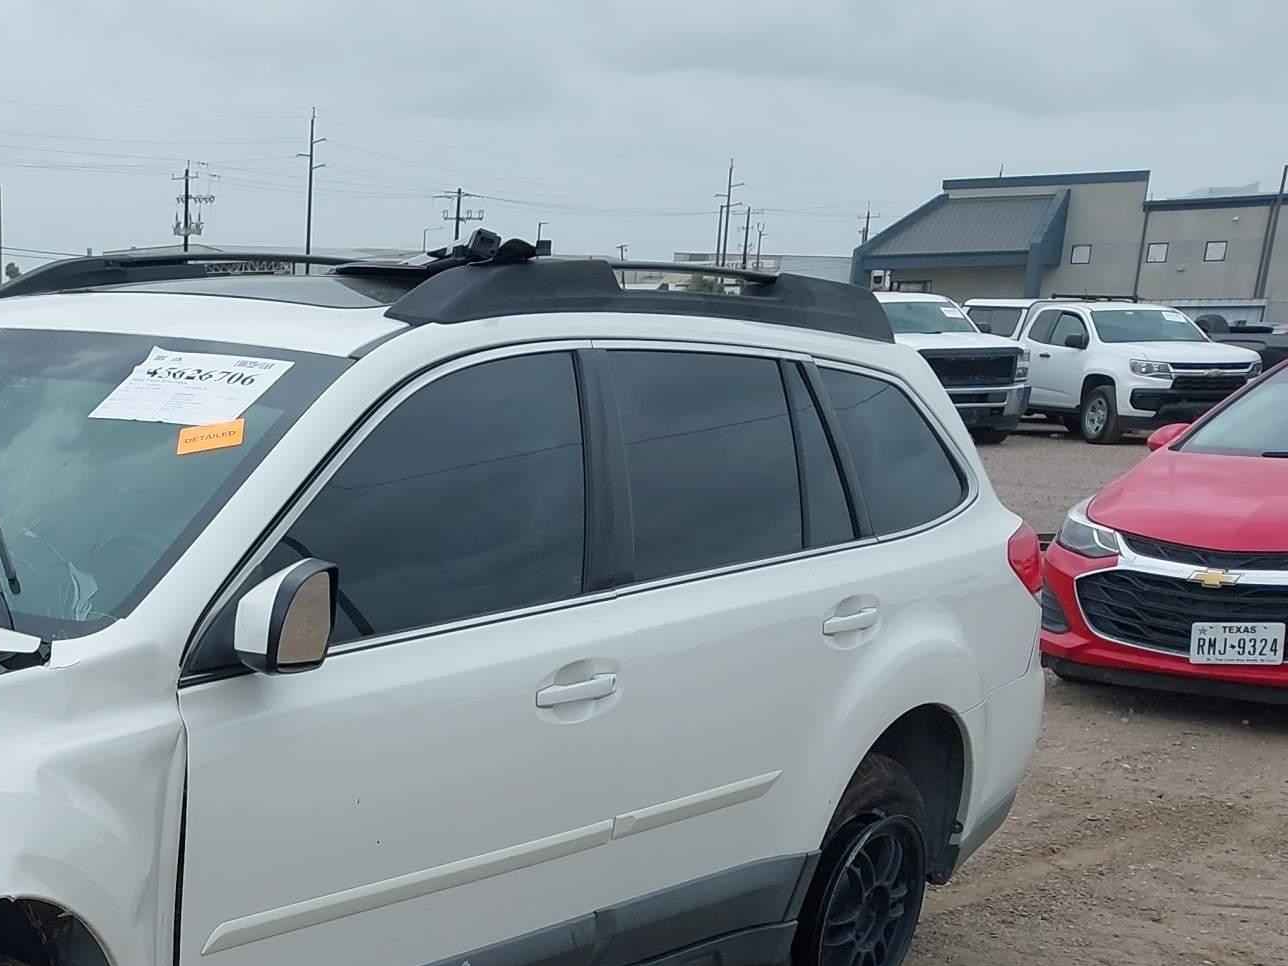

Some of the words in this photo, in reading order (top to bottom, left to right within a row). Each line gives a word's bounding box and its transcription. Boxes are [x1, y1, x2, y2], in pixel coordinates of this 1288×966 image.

[146, 366, 261, 386] 45626706
[184, 430, 236, 444] DETAILED
[1222, 625, 1257, 634] TEXAS
